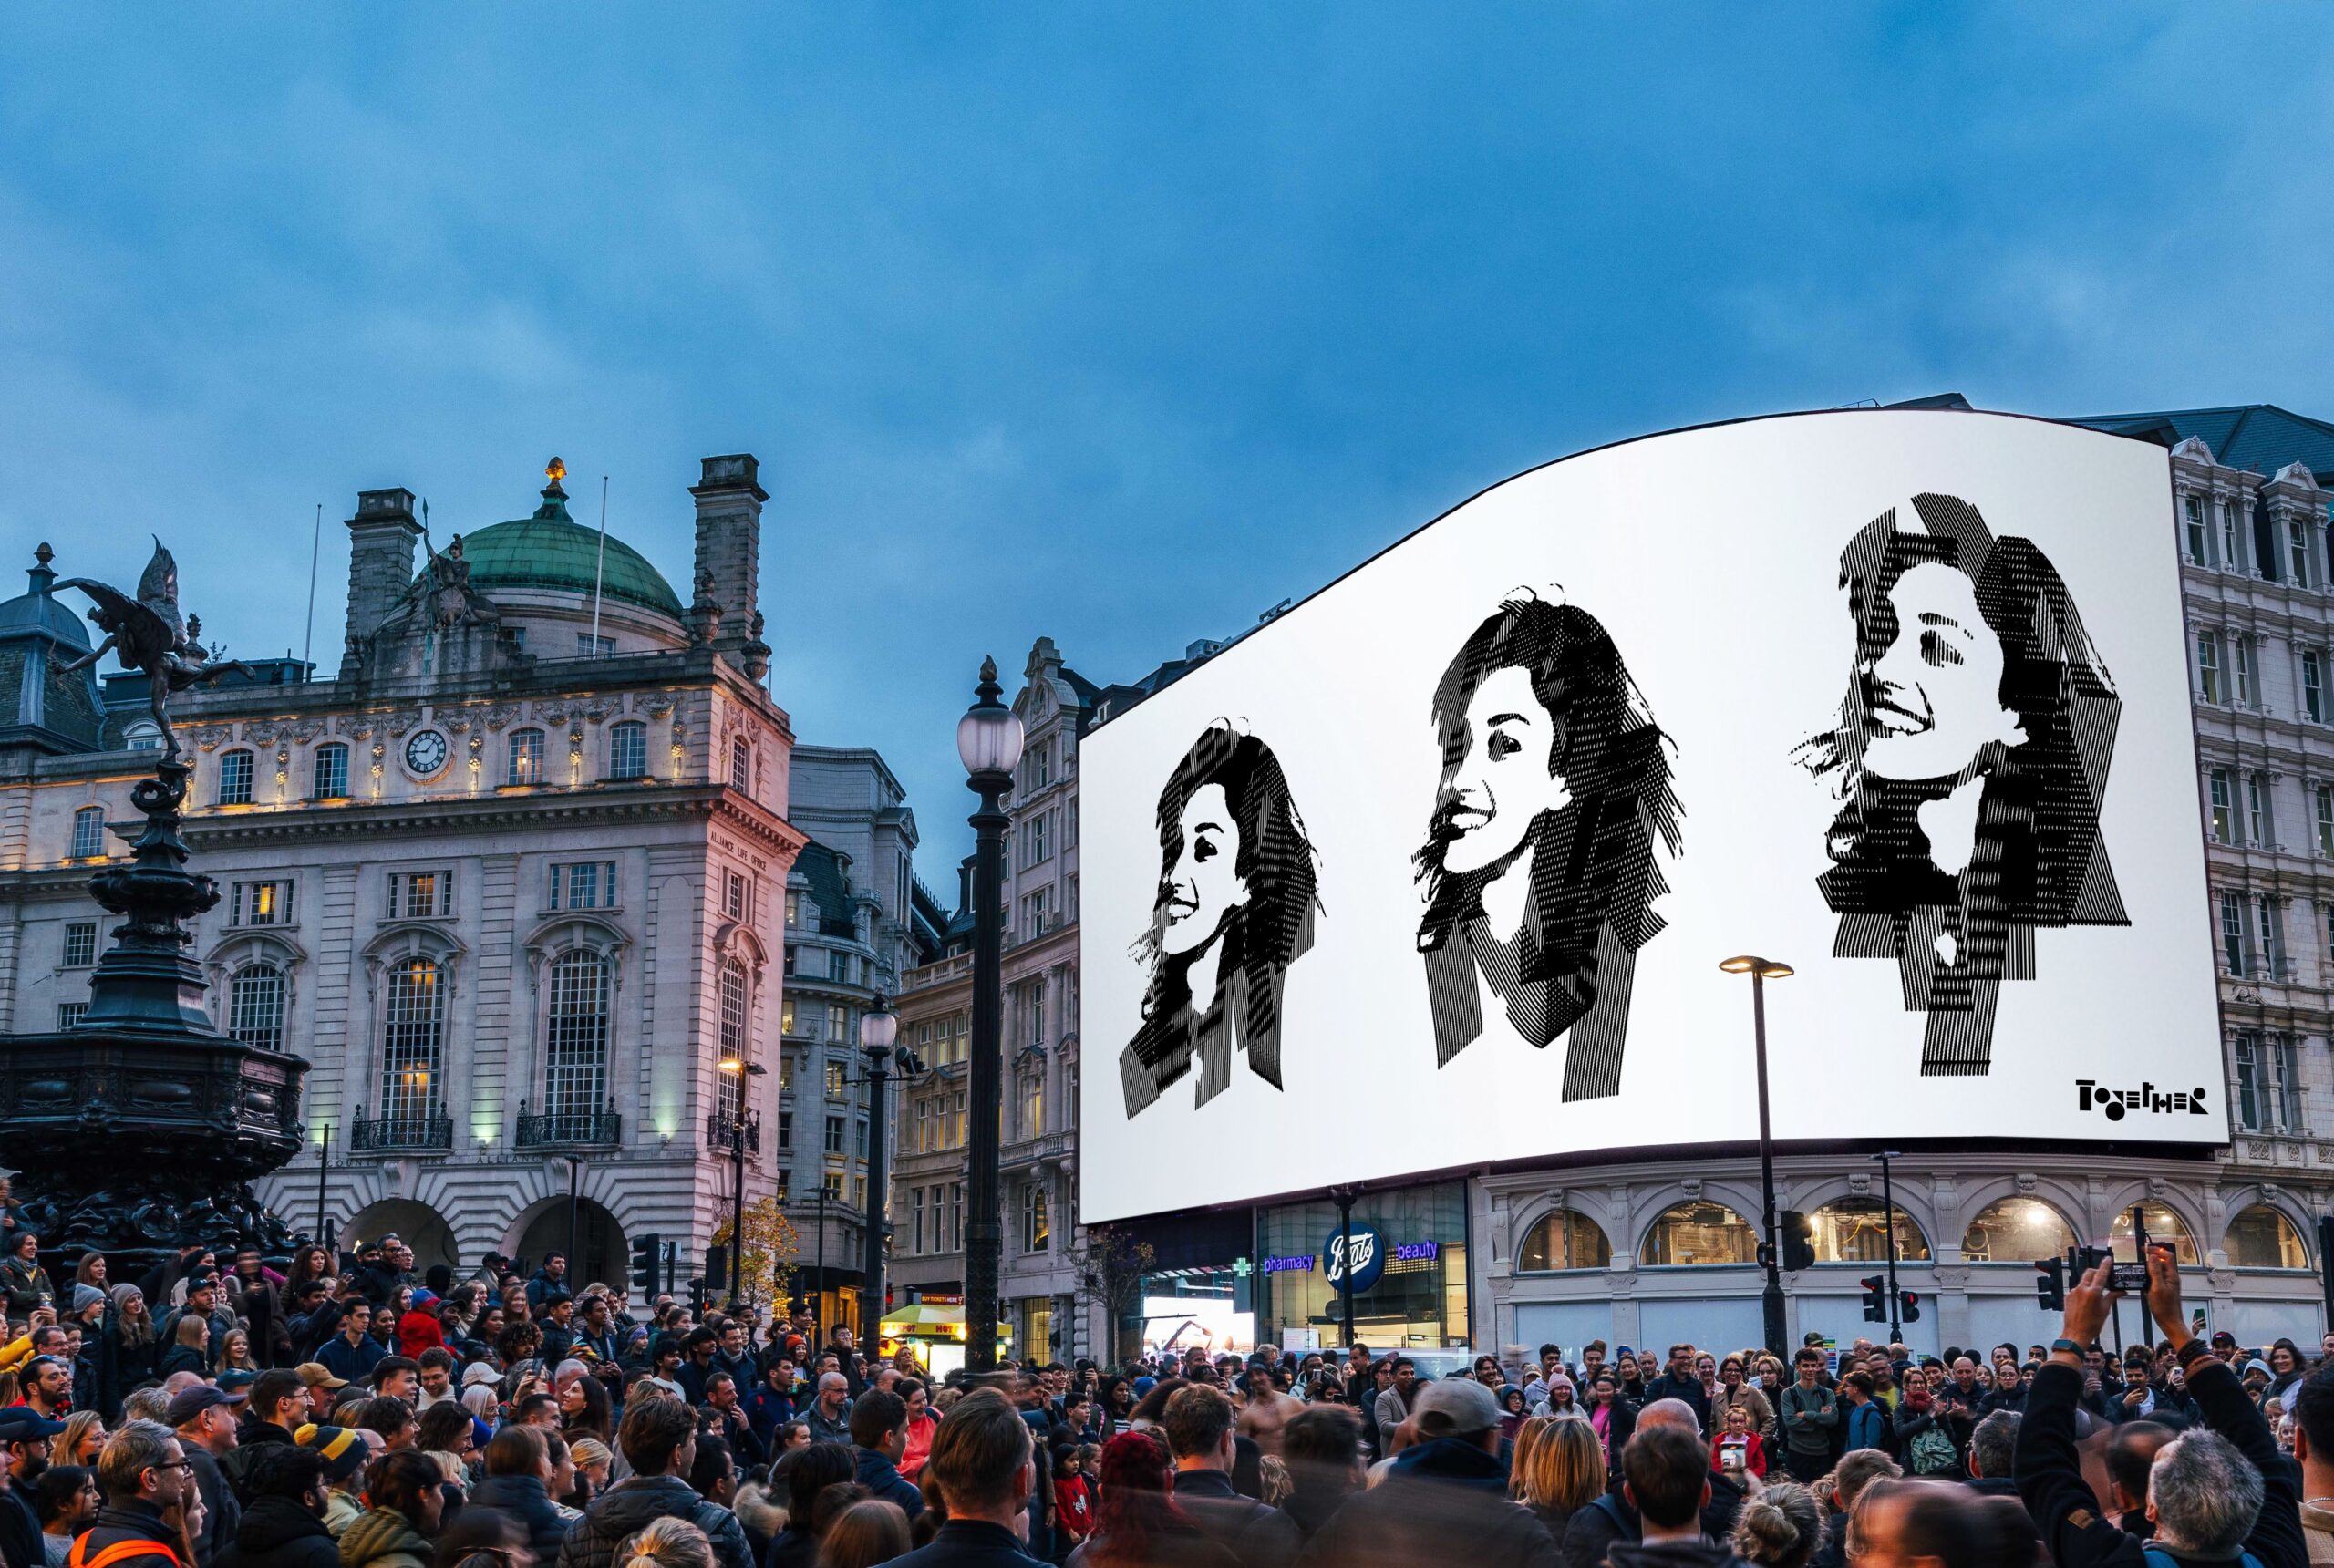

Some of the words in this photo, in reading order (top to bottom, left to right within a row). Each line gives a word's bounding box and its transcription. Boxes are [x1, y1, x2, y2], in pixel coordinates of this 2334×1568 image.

[710, 830, 734, 853] ALLIANCE
[738, 846, 748, 861] LIFE
[751, 855, 767, 872] OFFICE
[476, 1154, 547, 1165] ALLIANCE
[1397, 1240, 1439, 1261] beauty
[1265, 1254, 1314, 1274] pharmacy
[935, 1325, 953, 1333] HOT
